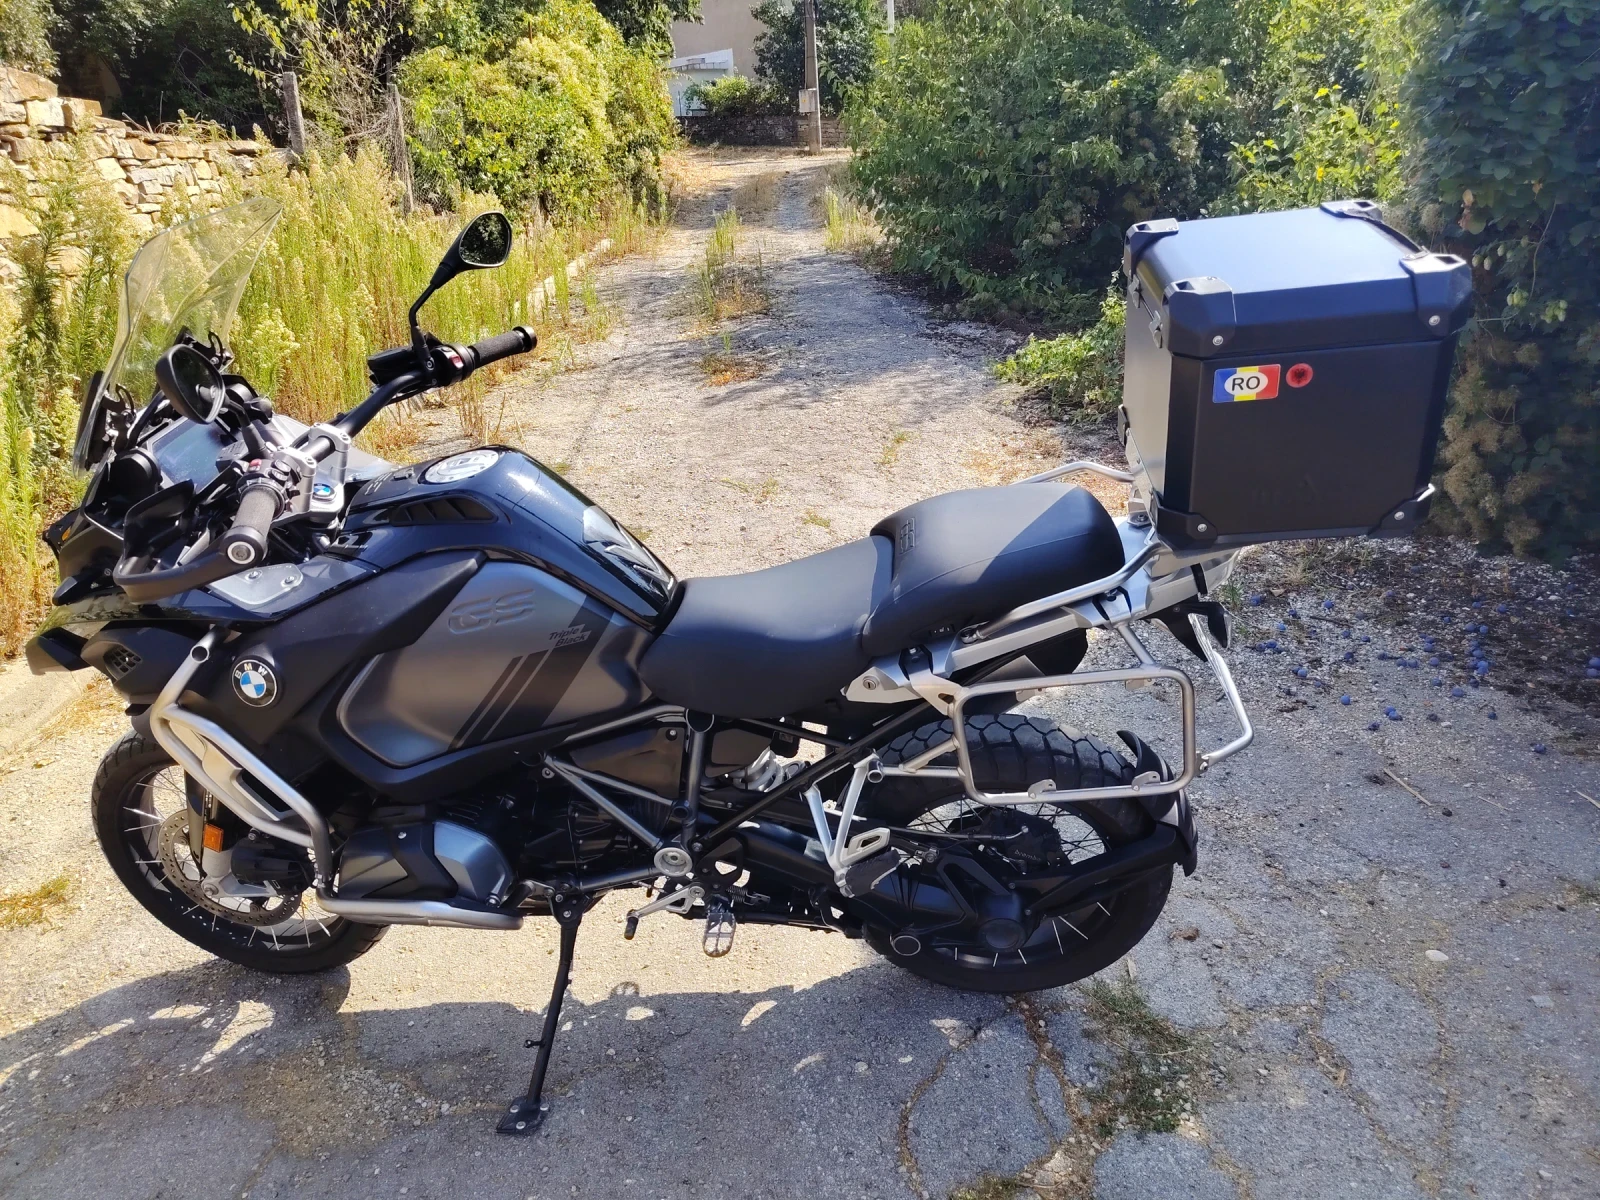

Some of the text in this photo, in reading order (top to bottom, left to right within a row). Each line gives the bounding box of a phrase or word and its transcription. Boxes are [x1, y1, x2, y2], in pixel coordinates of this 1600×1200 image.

[1231, 375, 1261, 392] RO
[447, 588, 536, 635] GS
[549, 627, 580, 641] Triple
[555, 633, 587, 647] Black
[234, 662, 268, 680] BMW
